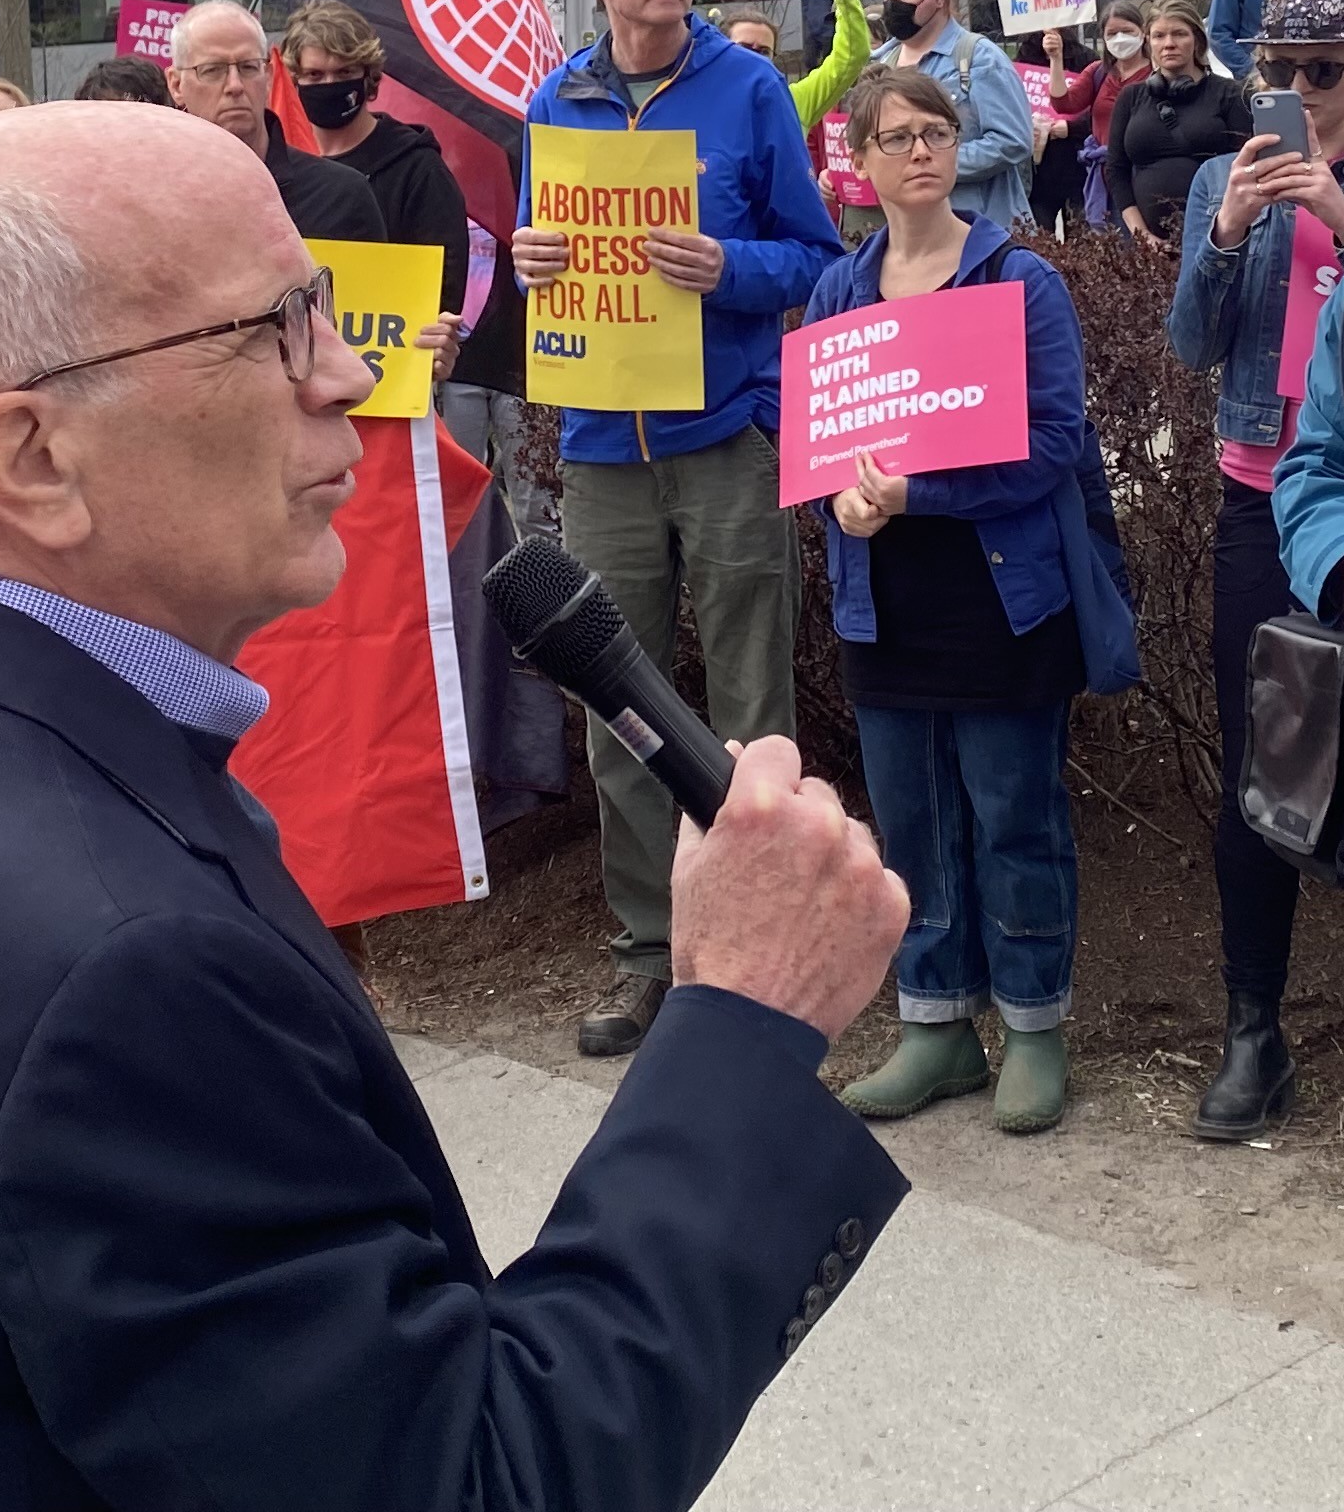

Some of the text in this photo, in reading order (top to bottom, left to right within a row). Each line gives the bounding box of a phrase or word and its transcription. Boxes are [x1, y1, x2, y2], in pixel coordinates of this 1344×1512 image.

[538, 181, 691, 227] ABORTION
[559, 232, 651, 275] CESS
[536, 279, 657, 323] FOR ALL.
[342, 311, 406, 348] UR
[533, 330, 586, 359] ACLU
[809, 319, 900, 363] I STAND
[533, 355, 565, 369] Vermont
[810, 353, 869, 388] WITH
[809, 368, 920, 416] PLANNED
[819, 447, 854, 465] Planned
